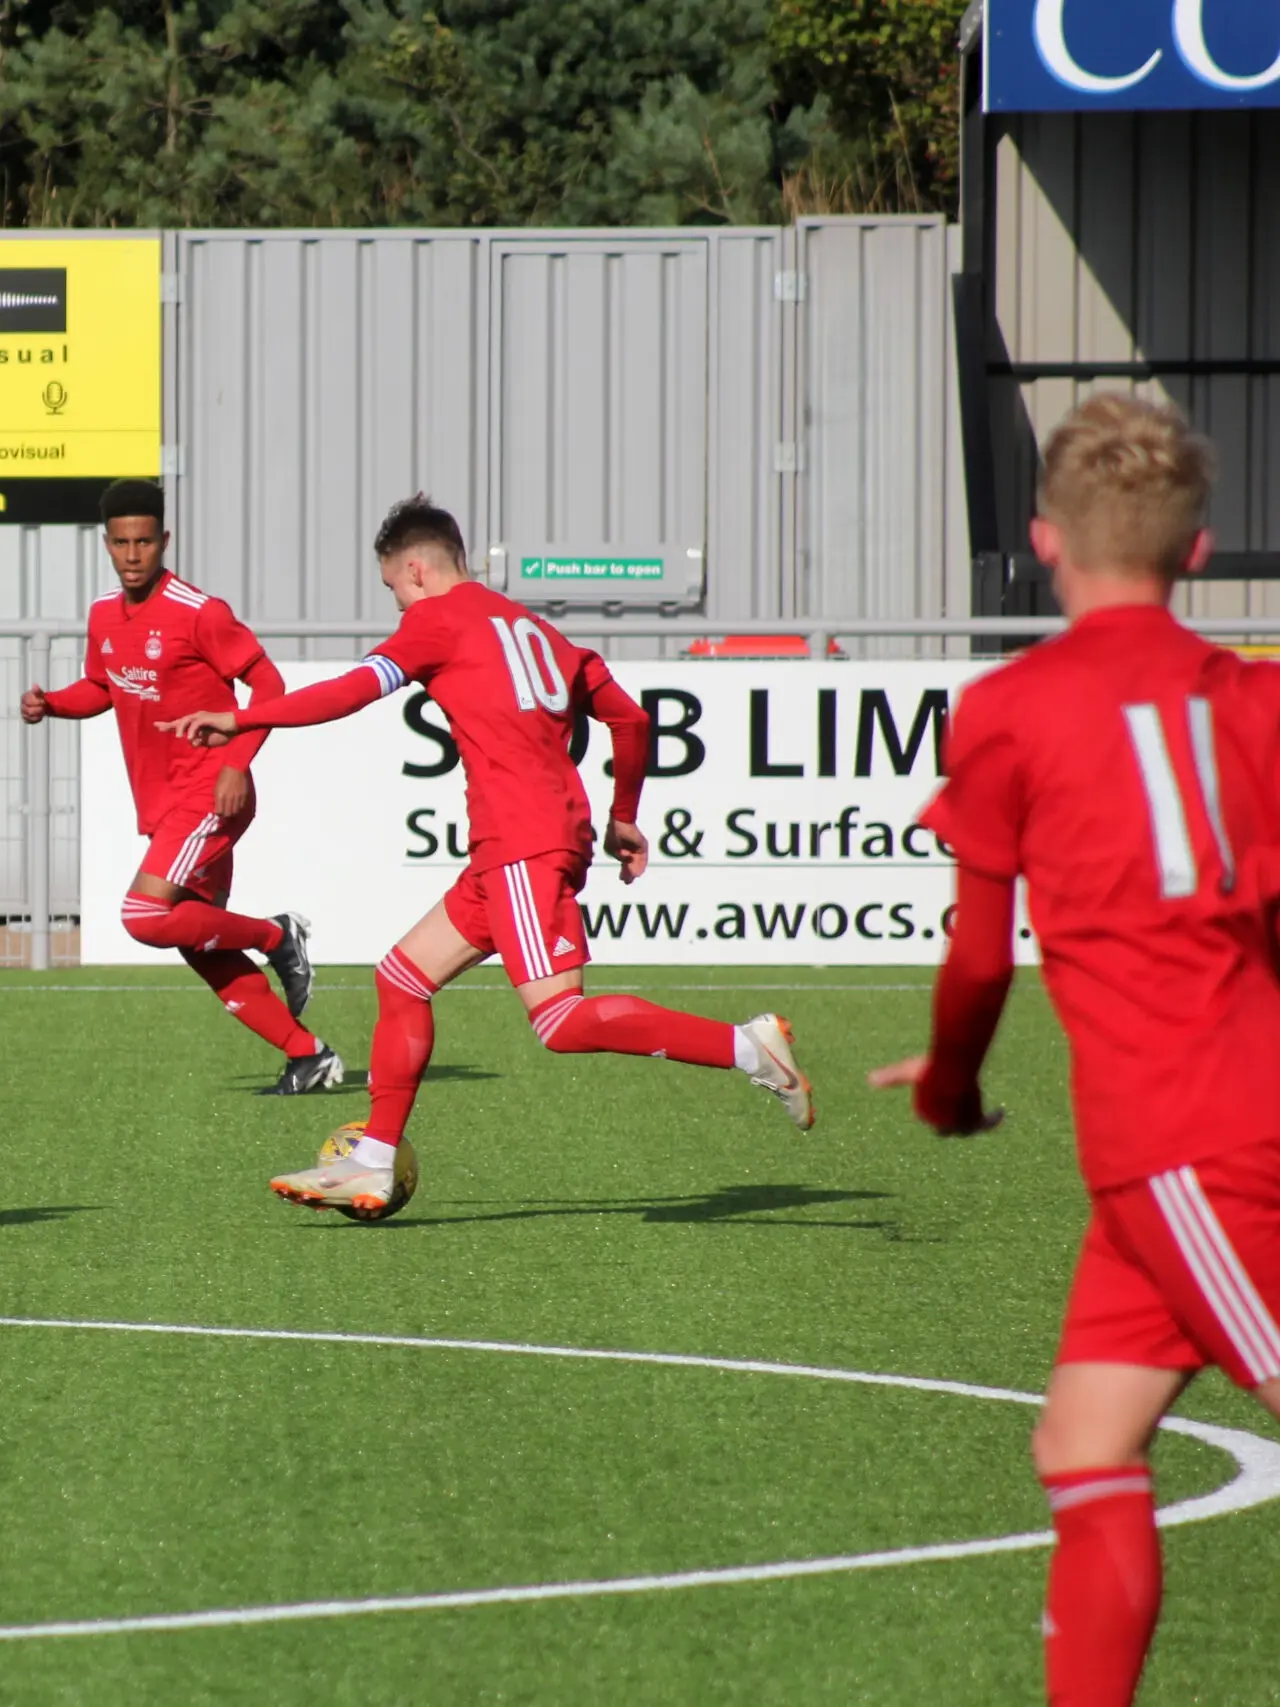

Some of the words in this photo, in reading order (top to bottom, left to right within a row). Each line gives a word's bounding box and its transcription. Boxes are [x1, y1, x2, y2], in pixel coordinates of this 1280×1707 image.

[547, 562, 581, 575] Push
[584, 562, 607, 575] bar
[610, 562, 625, 575] to
[627, 566, 661, 578] open
[488, 615, 568, 713] 10
[658, 807, 705, 859] &
[1121, 695, 1237, 901] 11
